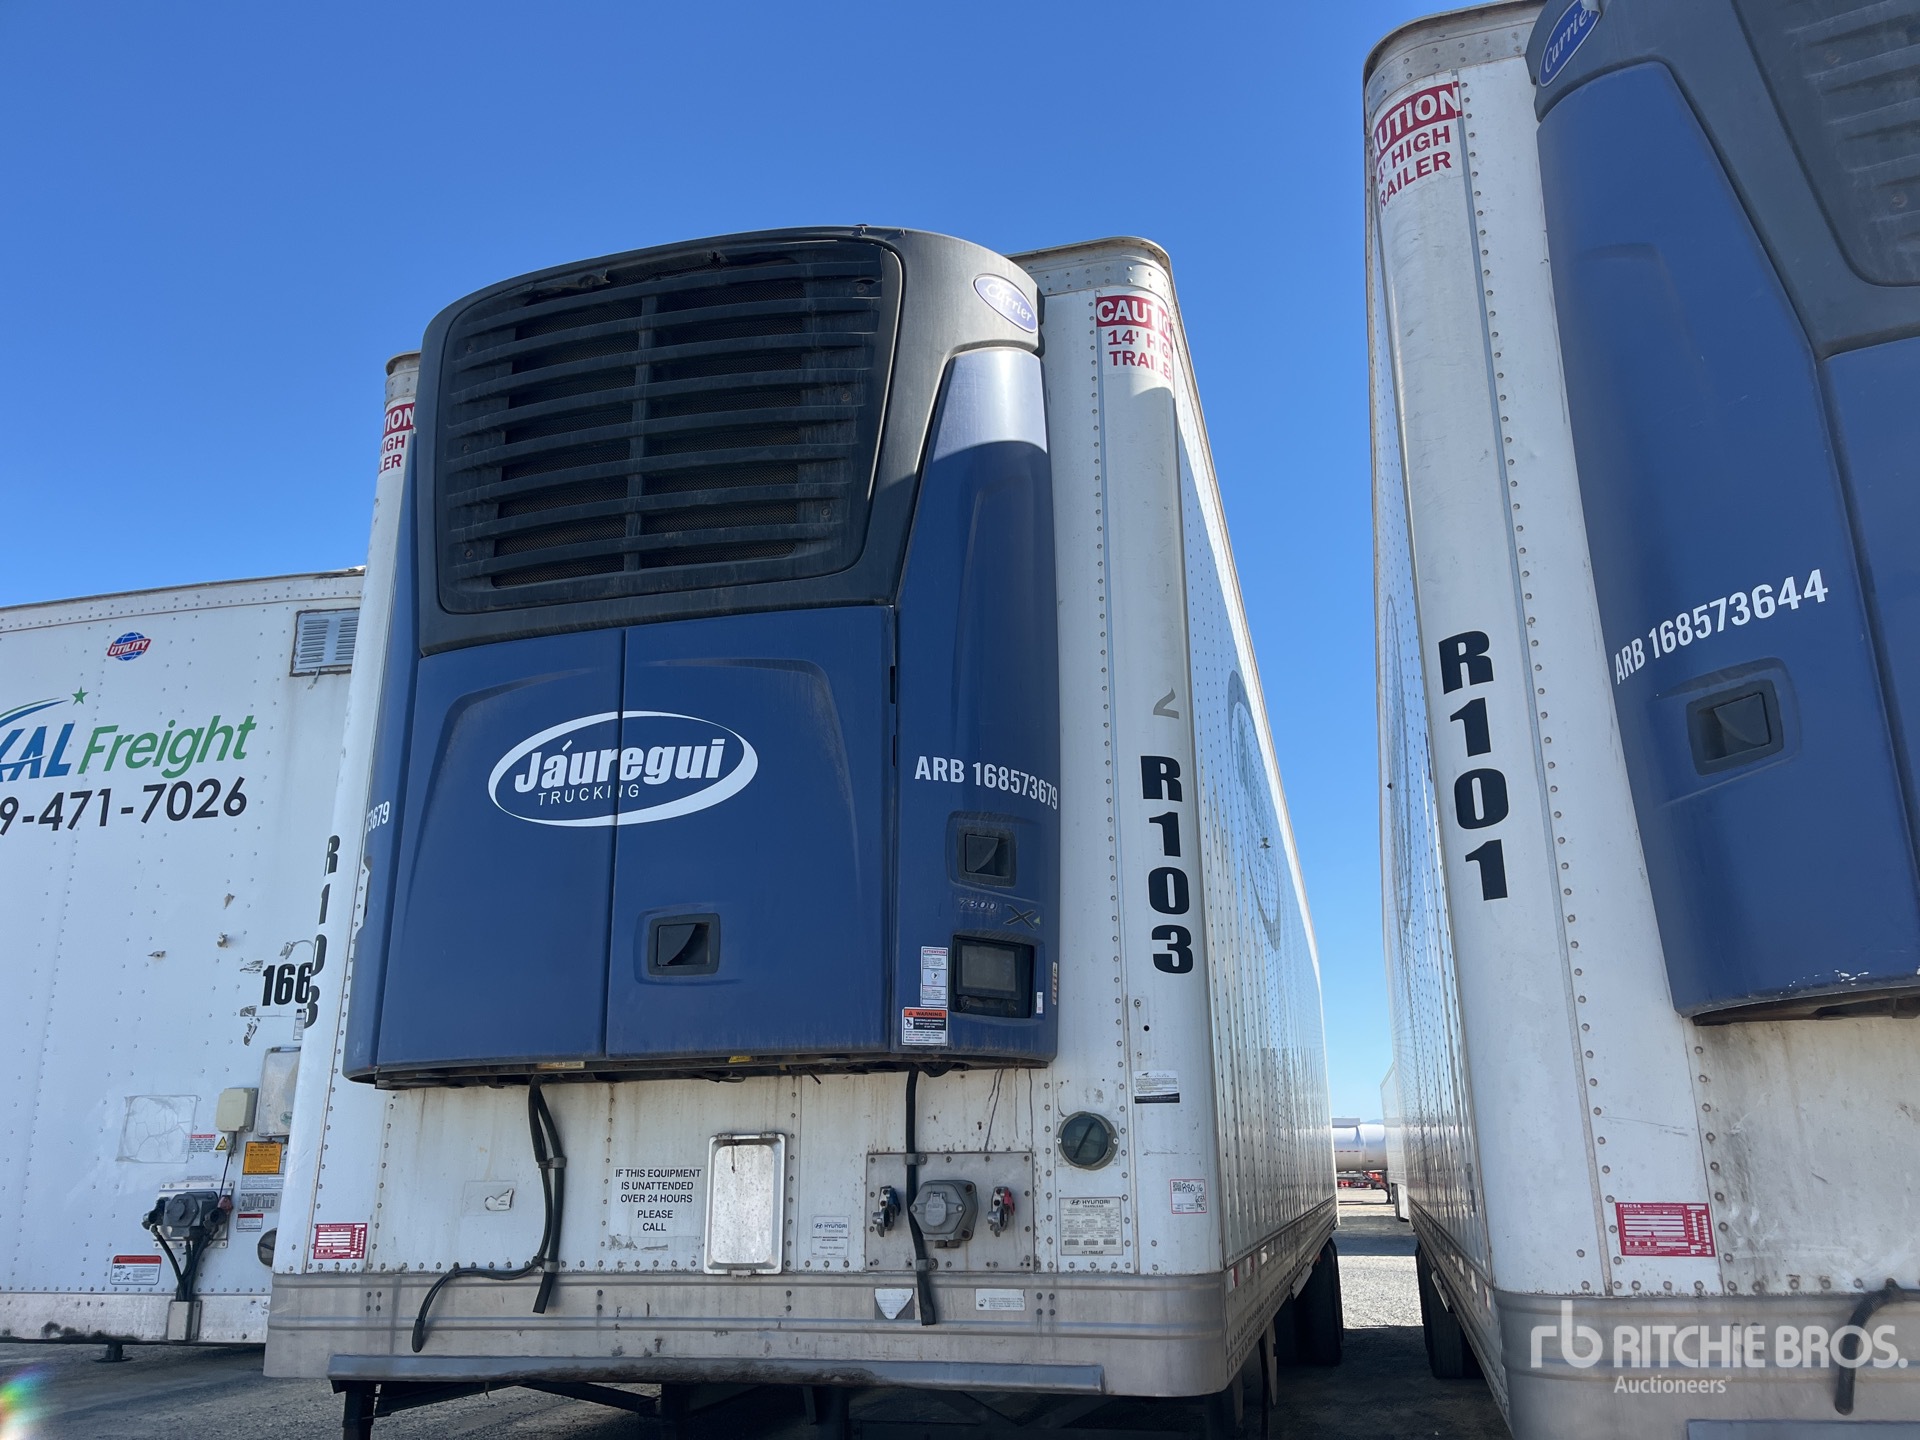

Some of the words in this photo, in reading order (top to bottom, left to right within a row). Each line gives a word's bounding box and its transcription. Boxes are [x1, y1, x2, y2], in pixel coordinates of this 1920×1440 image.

[1391, 125, 1451, 169] HIGH
[985, 283, 1032, 322] Carrier
[1096, 299, 1172, 344] CAUTIO
[1108, 329, 1139, 346] 14'
[1614, 637, 1646, 685] ARB
[1648, 568, 1829, 660] 168573644
[110, 640, 148, 656] UTILITY
[77, 715, 257, 779] Freight
[514, 738, 726, 793] Jáuregui
[1438, 630, 1510, 902] R101
[537, 784, 640, 806] TRUCKING
[914, 755, 965, 783] ARB
[972, 761, 1058, 811] 168573679
[1140, 755, 1194, 974] R103
[615, 1169, 623, 1178] IF
[625, 1169, 646, 1178] THIS
[647, 1169, 701, 1178] EQUIPMENT
[621, 1182, 630, 1191] IS
[632, 1182, 694, 1190] UNATTENDED
[620, 1194, 645, 1203] OVER
[647, 1194, 658, 1203] 24
[660, 1194, 693, 1203] HOURS
[637, 1210, 673, 1219] PLEASE
[642, 1223, 667, 1232] CALL
